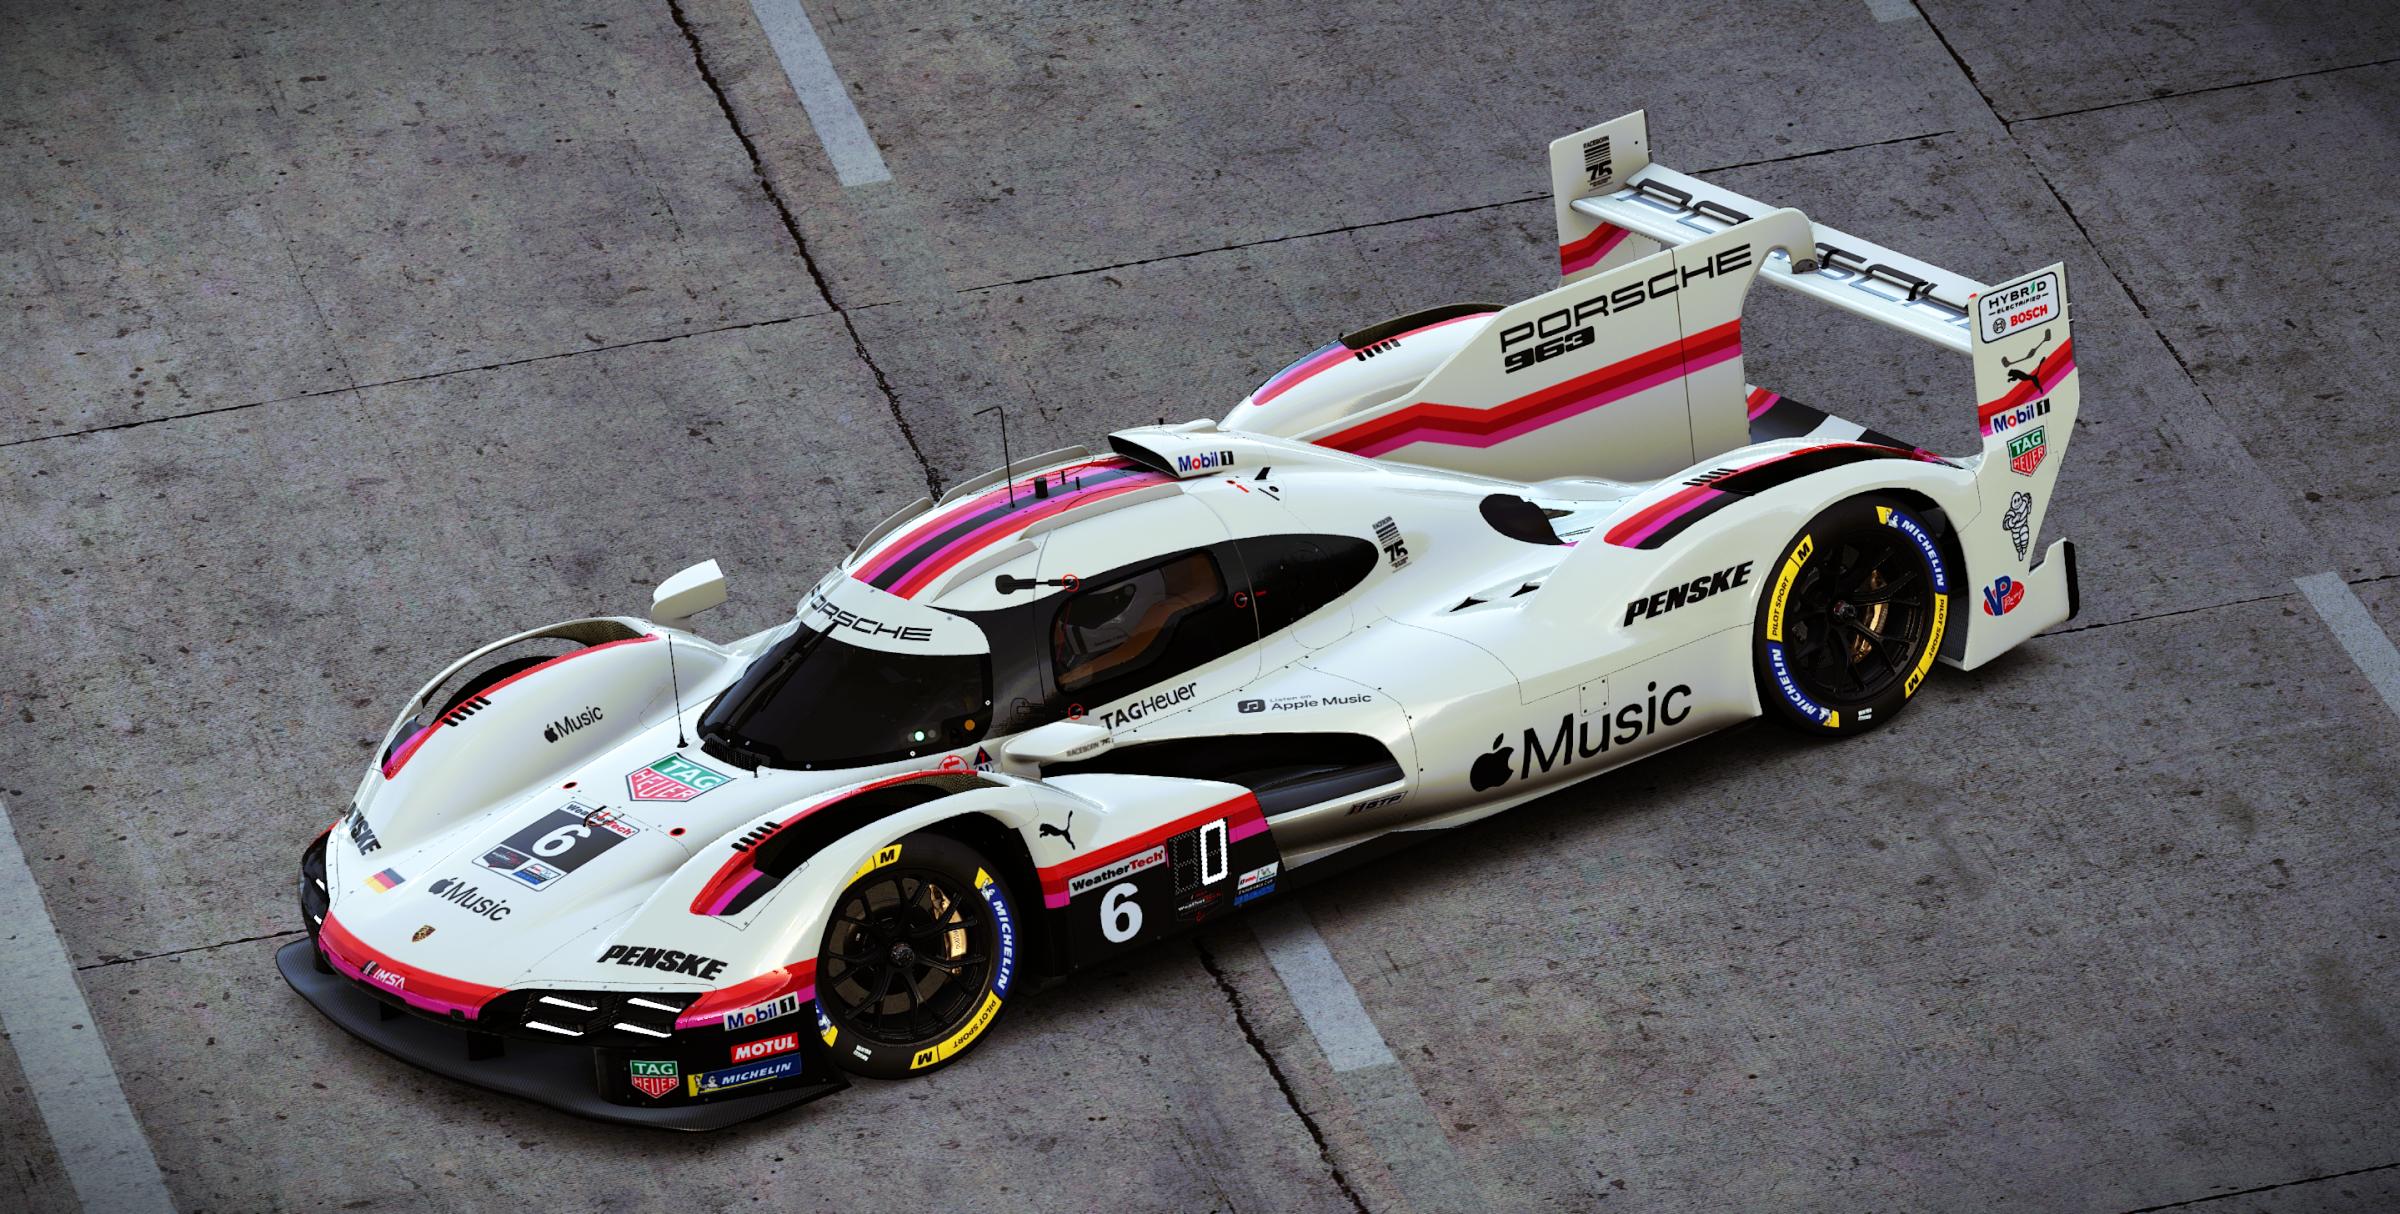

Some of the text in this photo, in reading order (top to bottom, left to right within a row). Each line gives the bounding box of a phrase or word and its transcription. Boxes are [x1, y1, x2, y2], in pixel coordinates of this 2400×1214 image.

[1586, 160, 1613, 181] 75
[1500, 243, 1752, 353] PORSCHE
[1988, 281, 2047, 309] HYBRID
[1996, 294, 2041, 314] ELECTRIFIED
[2010, 304, 2048, 327] BOSCH
[1504, 325, 1595, 375] 963
[1993, 399, 2049, 435] Mobil 1
[2010, 432, 2043, 455] TAG
[2013, 446, 2045, 471] HEUER
[1178, 451, 1233, 473] Mobil 1
[1383, 539, 1409, 562] 75
[1797, 545, 1811, 562] M
[1901, 519, 1944, 587] MICHELIN
[1623, 560, 1754, 627] PENSKE
[1772, 576, 1790, 637] PILOT SPORT
[1983, 575, 2012, 616] VP
[1928, 599, 1945, 658] PILOT SPORT
[1772, 649, 1817, 715] MICHELIN
[1269, 695, 1299, 703] Listen
[1271, 694, 1373, 711] Apple Music
[554, 705, 604, 738] Music
[1520, 680, 1692, 780] Music
[634, 769, 697, 800] HEUER
[662, 760, 721, 788] TAG
[532, 823, 592, 857] 6
[880, 849, 895, 864] M
[1071, 849, 1164, 892] WeatherTech
[443, 881, 511, 922] Music
[1100, 882, 1143, 944] 6
[992, 901, 1013, 990] MICHELIN
[597, 945, 728, 981] PENSKE
[373, 968, 406, 990] IMSA
[727, 1007, 778, 1030] Mobil
[782, 997, 793, 1013] 1
[953, 1000, 997, 1049] PILOT SPORT
[734, 1035, 796, 1060] MOTUL
[917, 1051, 933, 1066] M
[634, 1062, 674, 1075] TAG
[721, 1062, 792, 1085] MICHELIN
[634, 1076, 677, 1095] HEUER
